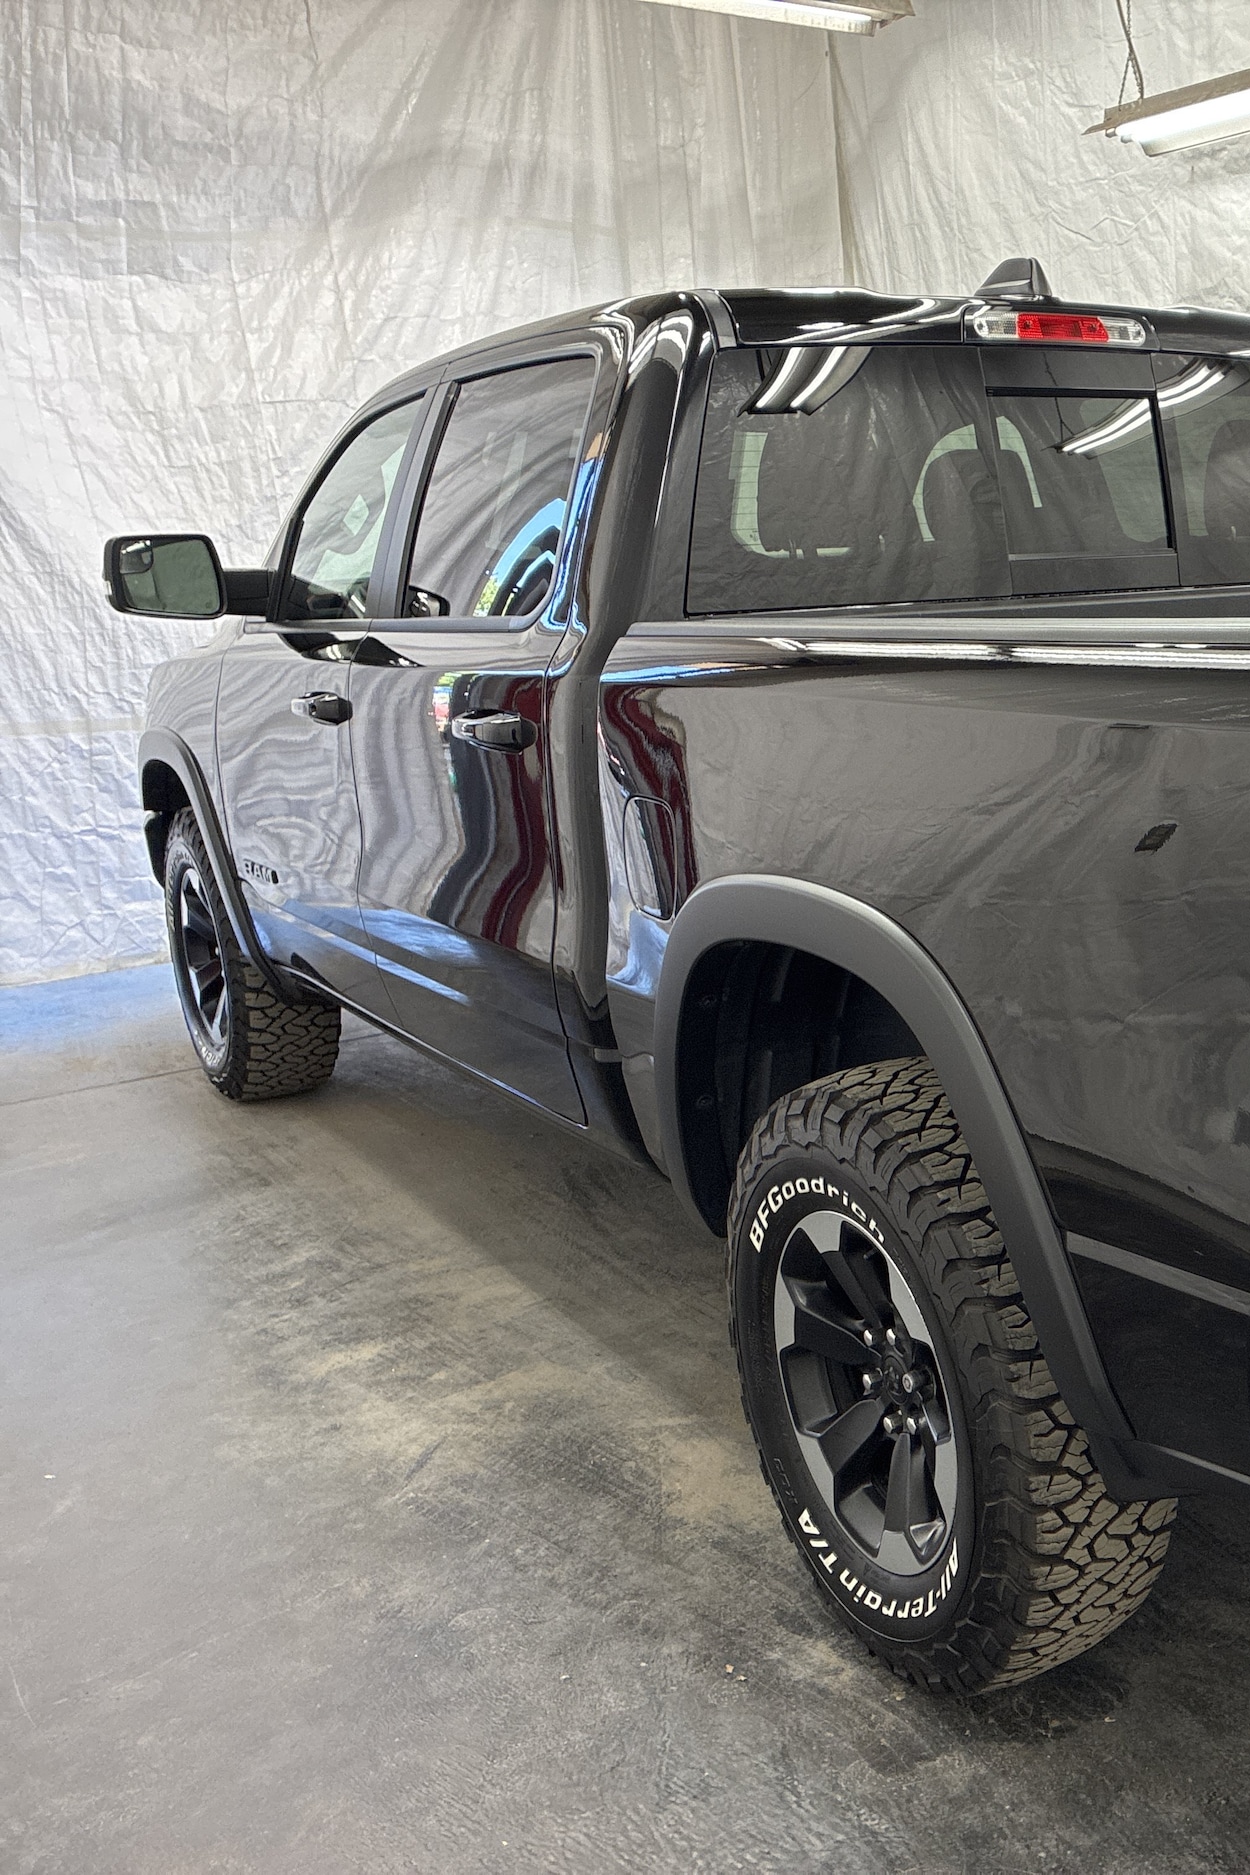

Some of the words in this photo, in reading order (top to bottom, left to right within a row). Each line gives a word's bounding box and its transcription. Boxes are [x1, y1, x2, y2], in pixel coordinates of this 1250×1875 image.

[749, 1176, 885, 1253] BFGoodrich
[797, 1507, 839, 1575] T/A
[838, 1536, 960, 1619] All-Terrain
